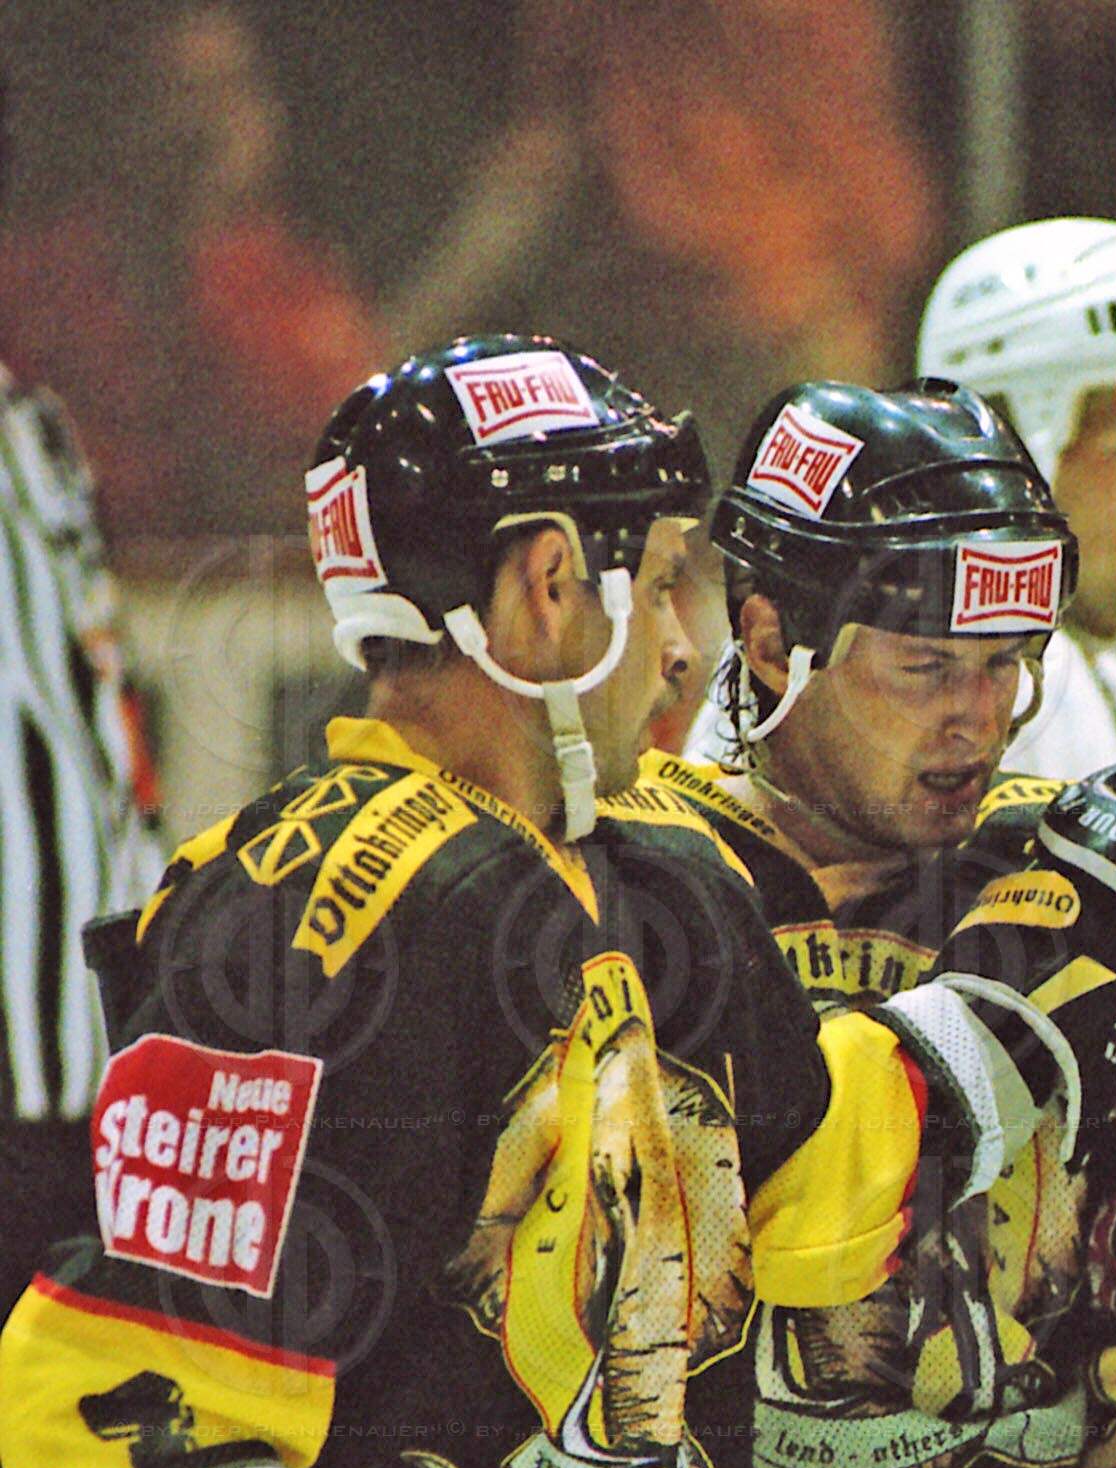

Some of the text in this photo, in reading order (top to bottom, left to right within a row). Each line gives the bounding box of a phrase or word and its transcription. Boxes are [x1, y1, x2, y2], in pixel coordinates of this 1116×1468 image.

[464, 370, 578, 424] FRU-FRU
[756, 430, 845, 495] FRU-FRU
[965, 562, 1056, 610] FRU-FRU
[308, 778, 456, 946] Ottakringer
[208, 1071, 293, 1116] Neue
